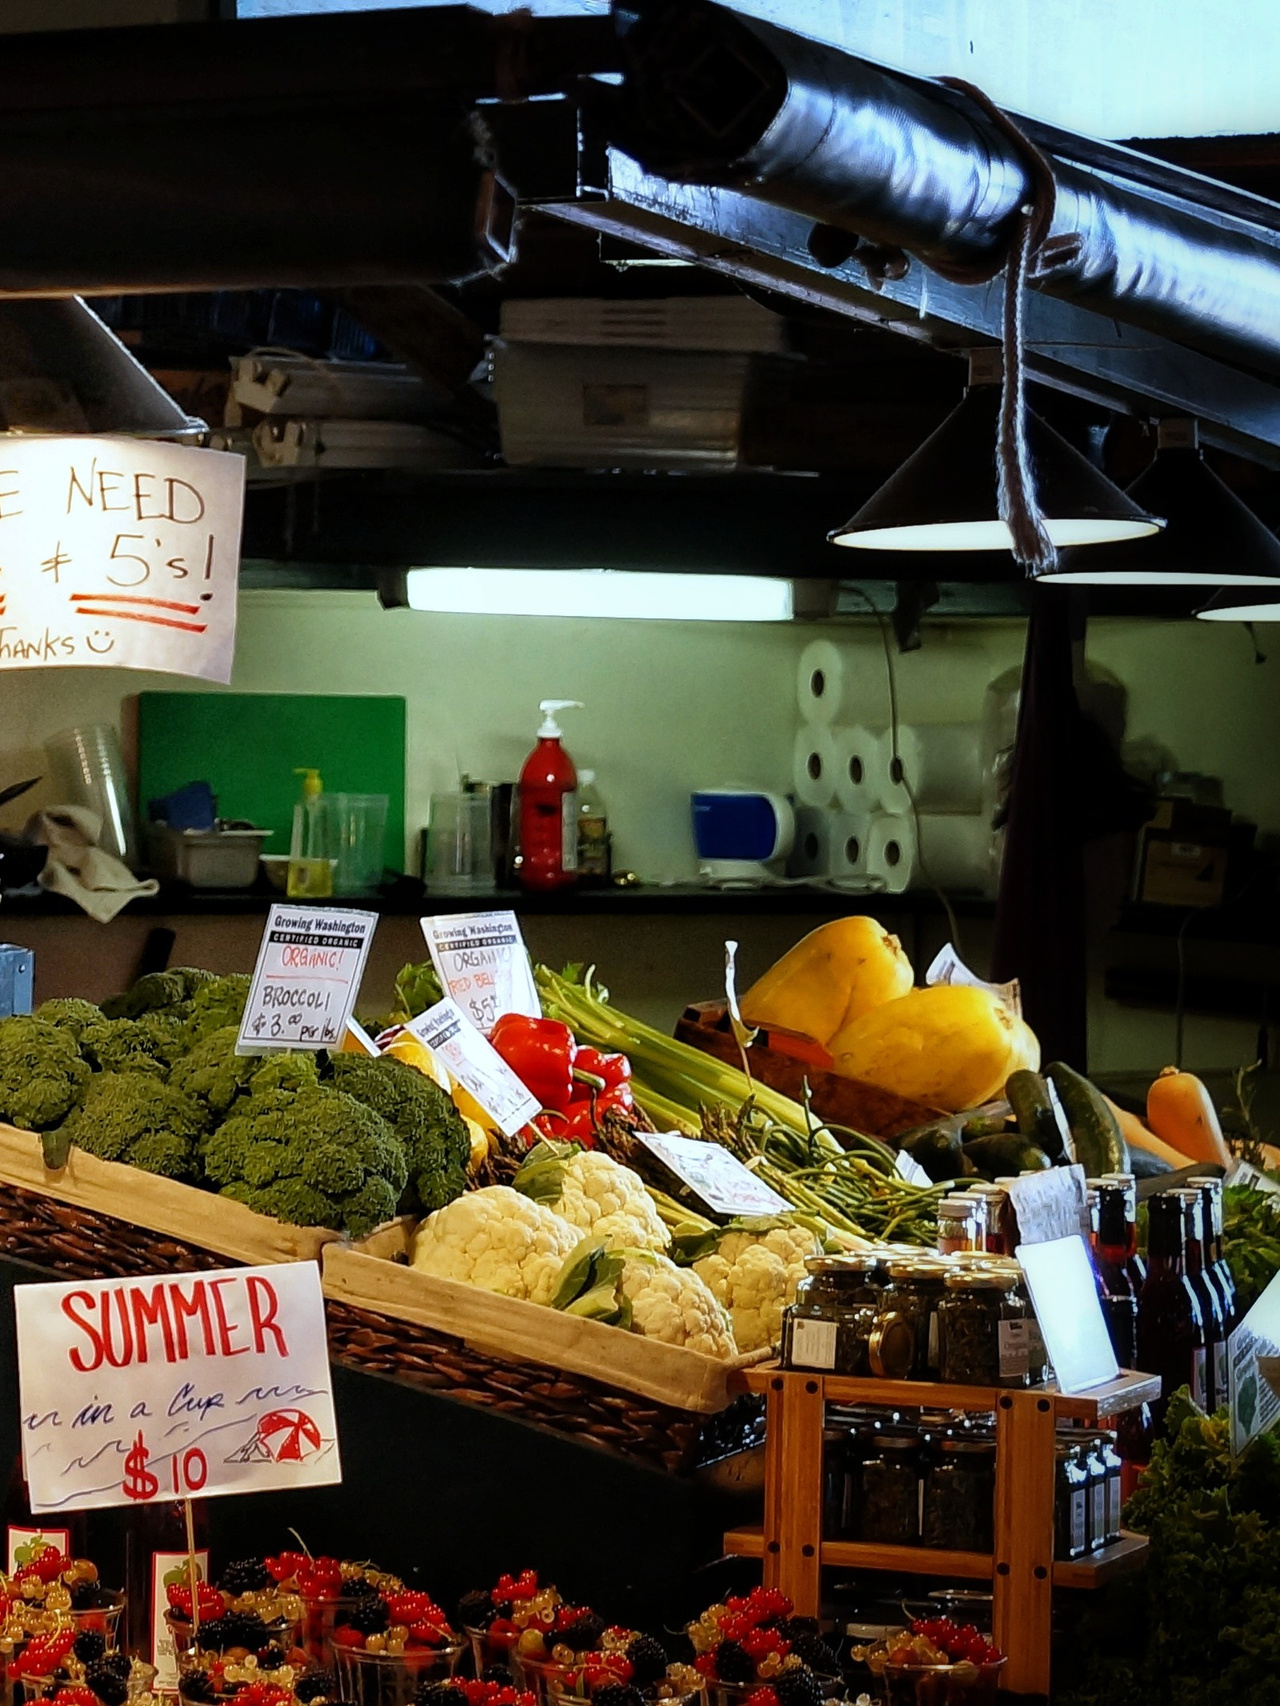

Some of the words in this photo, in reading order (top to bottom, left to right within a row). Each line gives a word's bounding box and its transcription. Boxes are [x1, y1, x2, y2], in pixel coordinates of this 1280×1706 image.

[66, 458, 206, 524] NEED
[275, 915, 313, 931] Growing
[315, 916, 366, 935] Washington
[433, 927, 468, 940] Growing
[468, 923, 513, 935] Washington
[273, 934, 319, 945] CERTIFIED
[322, 937, 358, 947] ORGANIC
[262, 985, 331, 1011] BROCCOLI
[61, 1276, 289, 1372] SUMMER
[72, 1395, 114, 1429] in
[129, 1402, 152, 1419] a
